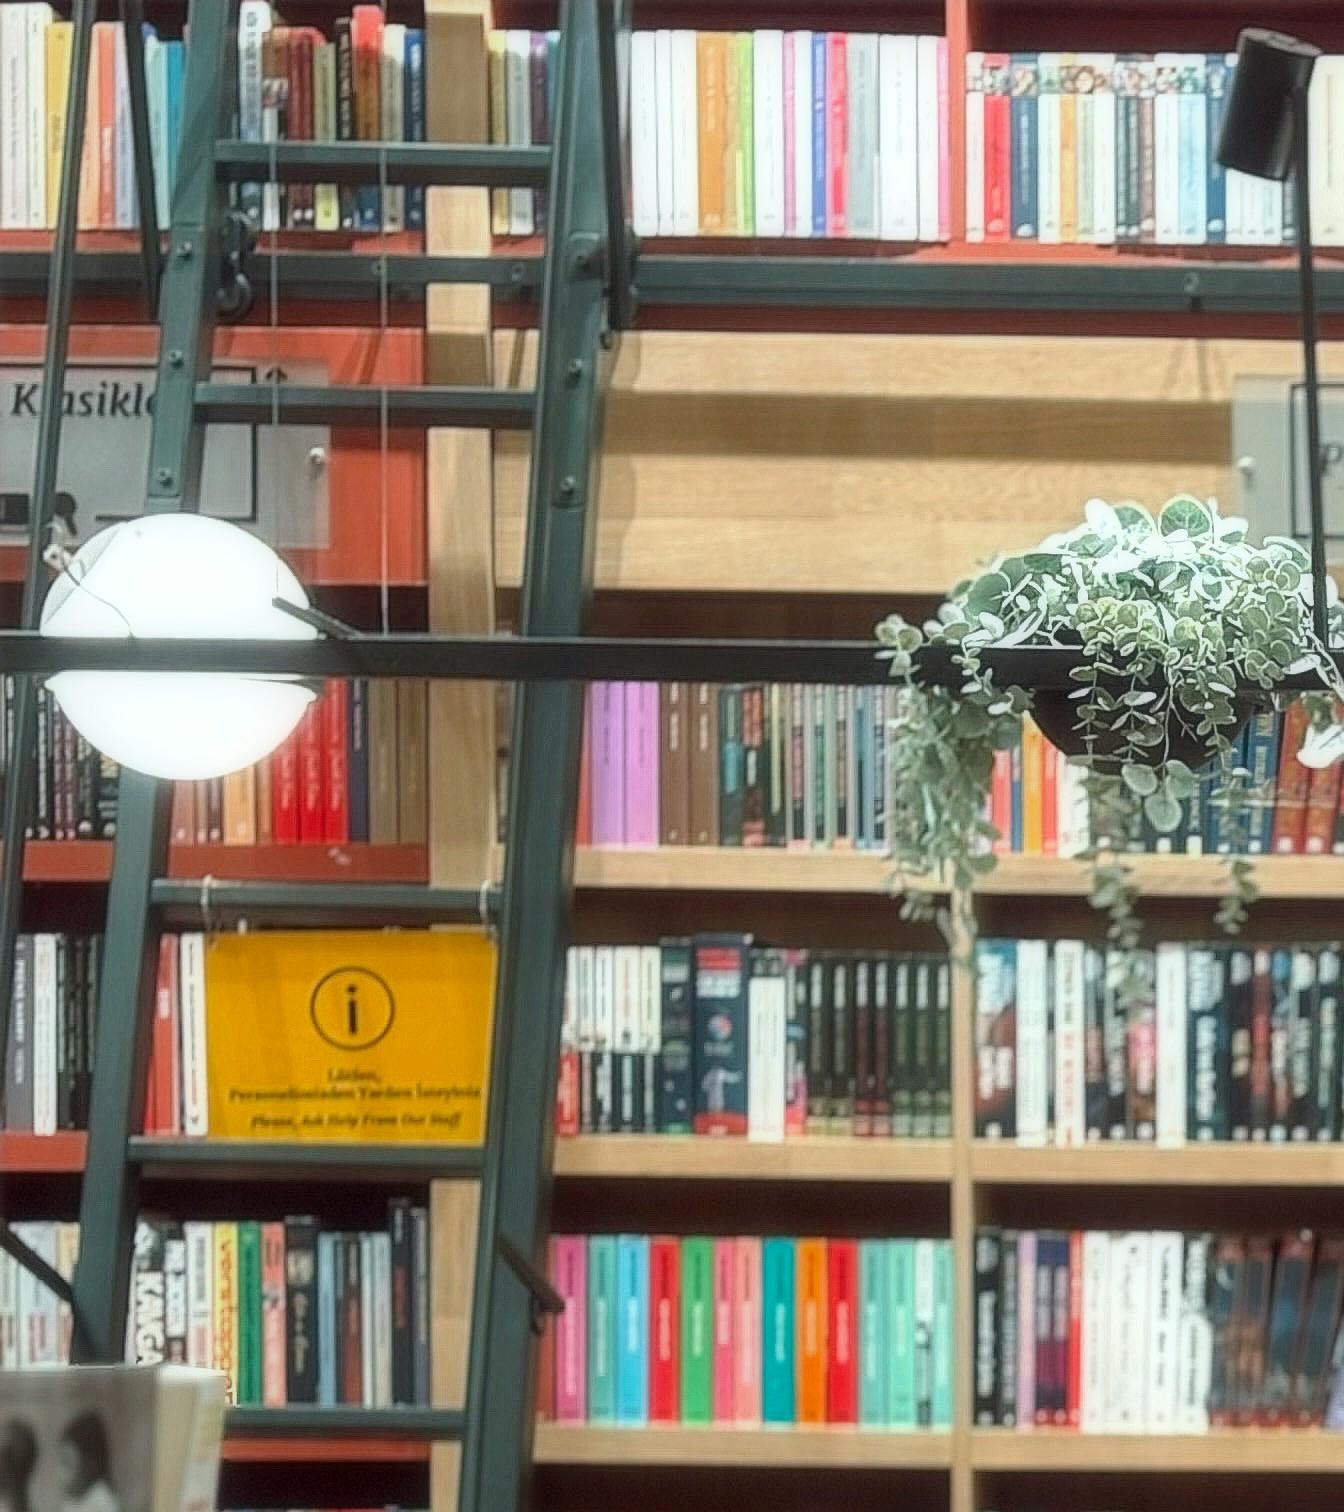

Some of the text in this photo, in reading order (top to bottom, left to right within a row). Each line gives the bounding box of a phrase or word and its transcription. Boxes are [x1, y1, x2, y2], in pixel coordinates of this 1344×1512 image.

[9, 381, 156, 417] Kasikl
[328, 1114, 357, 1129] Help
[361, 1113, 398, 1126] From
